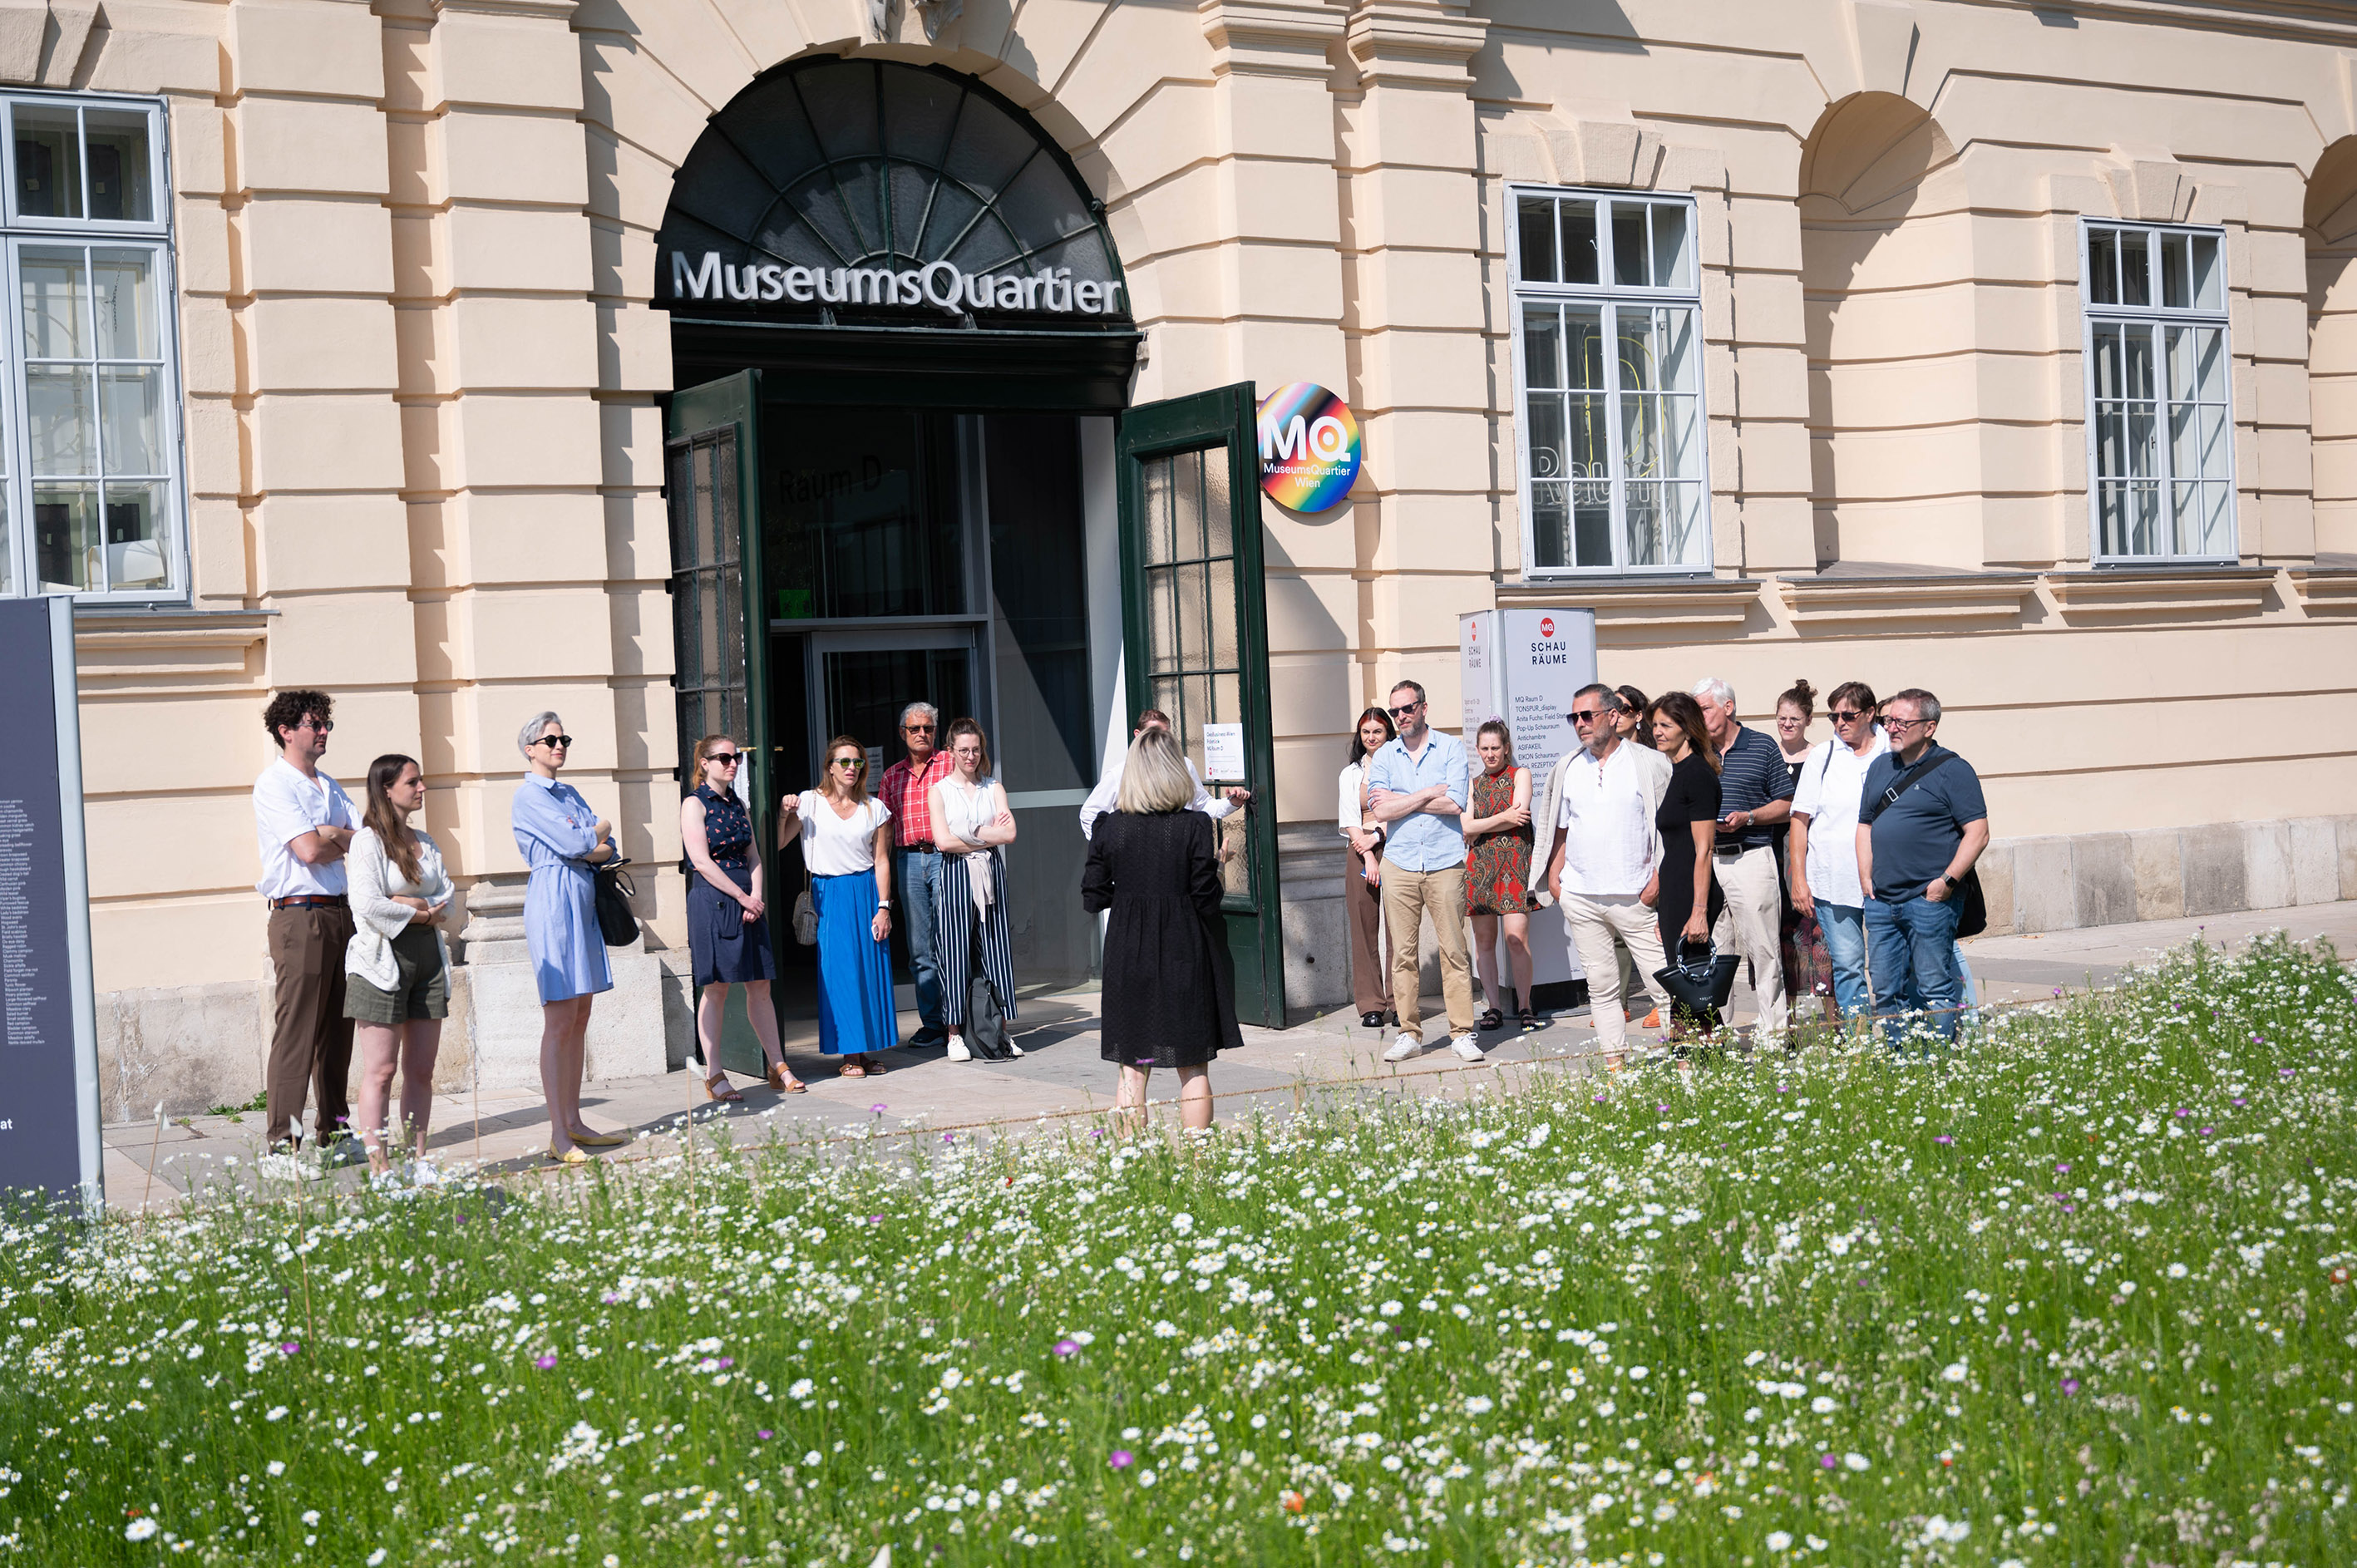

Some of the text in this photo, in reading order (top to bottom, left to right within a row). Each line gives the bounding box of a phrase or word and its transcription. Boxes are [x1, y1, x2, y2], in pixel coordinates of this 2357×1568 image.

[672, 251, 1122, 314] MuseumsQuartier
[1262, 414, 1351, 462] MQ
[1264, 463, 1351, 476] MuseumsQuartier
[779, 454, 882, 505] Raum D
[1294, 477, 1320, 488] Wien
[1541, 623, 1554, 632] MQ
[1531, 641, 1566, 652] SCHAU
[1532, 653, 1566, 665] RÄUME
[1516, 704, 1556, 713] TONSPUR_display
